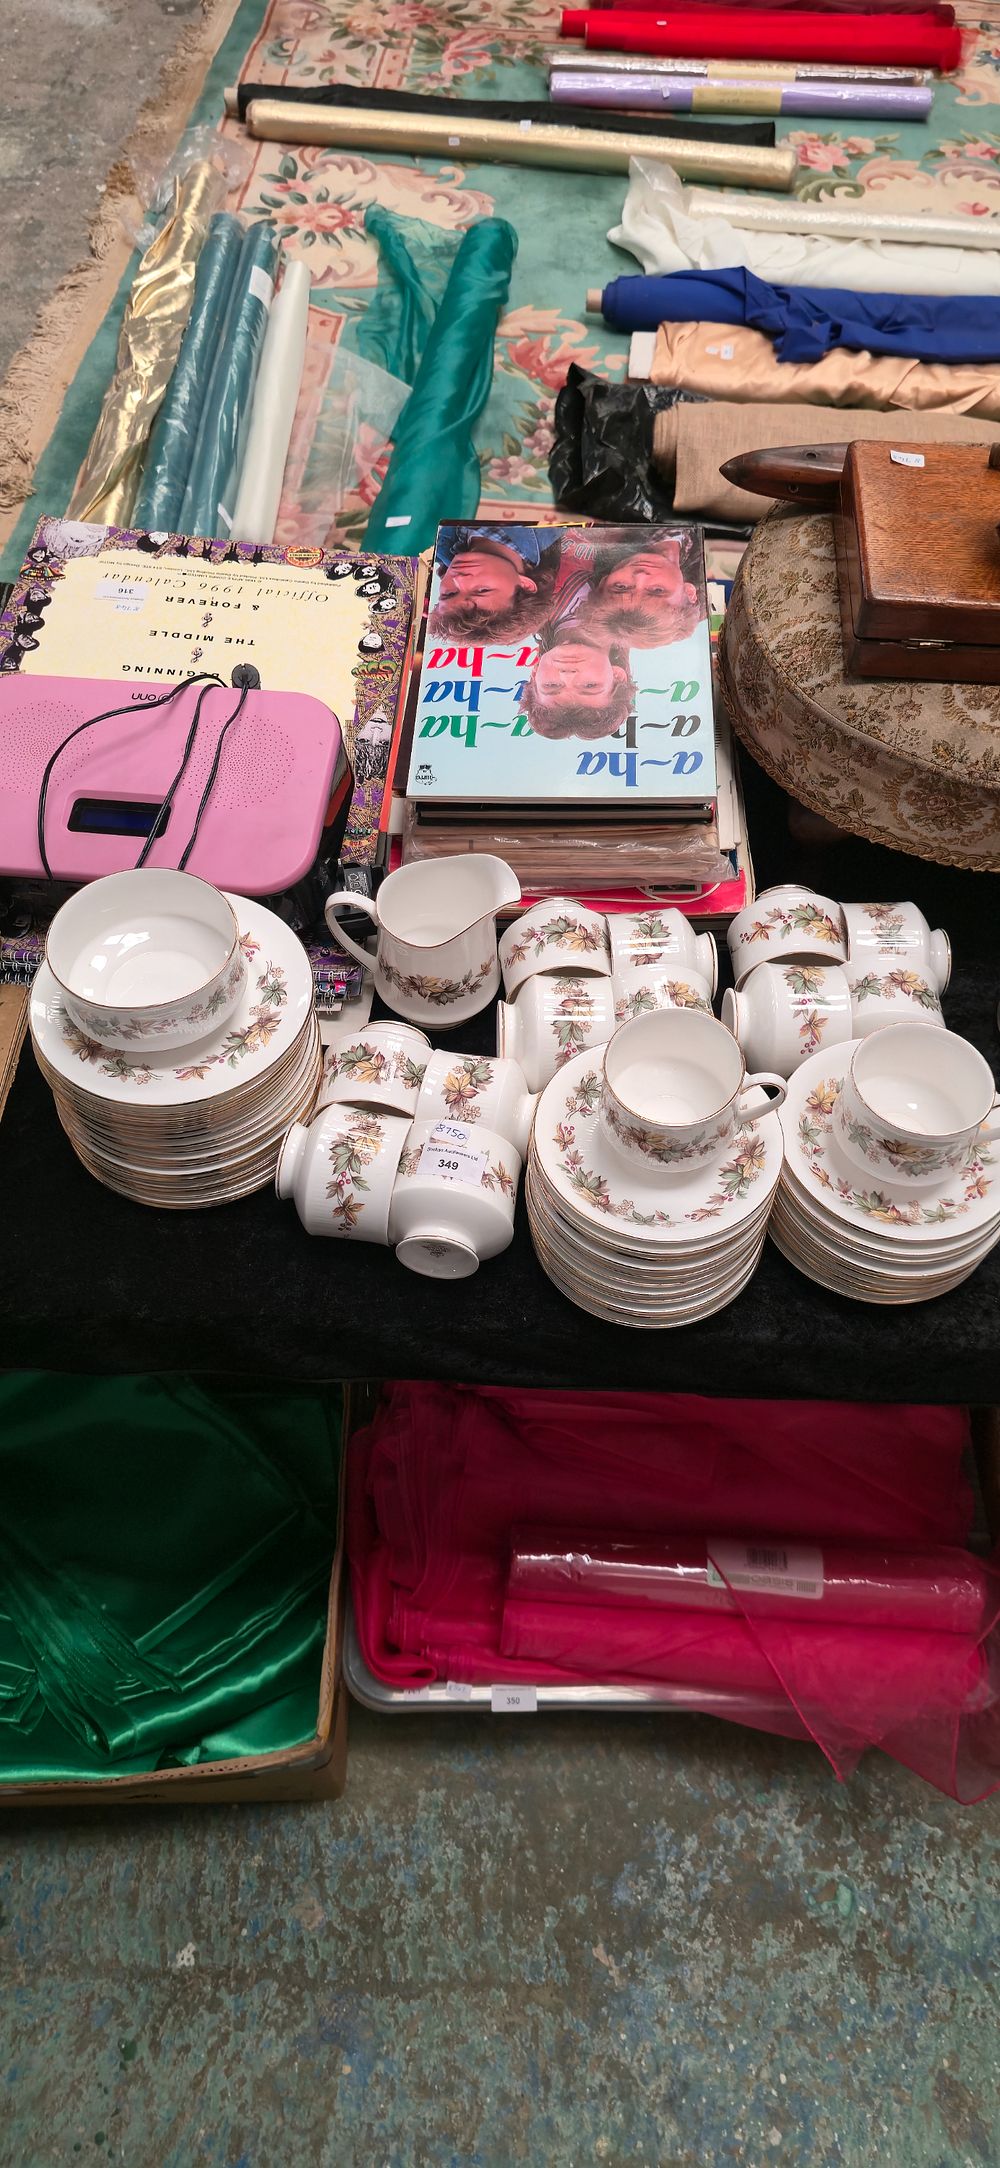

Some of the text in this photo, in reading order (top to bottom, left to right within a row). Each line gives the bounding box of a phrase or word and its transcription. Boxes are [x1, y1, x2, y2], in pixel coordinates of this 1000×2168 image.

[102, 572, 186, 588] Calendar
[199, 582, 243, 594] 1996
[256, 588, 329, 603] Official
[165, 596, 241, 610] FOREVER
[149, 629, 255, 646] THE MIDDLE
[131, 693, 157, 701] onn
[438, 1159, 459, 1170] 349
